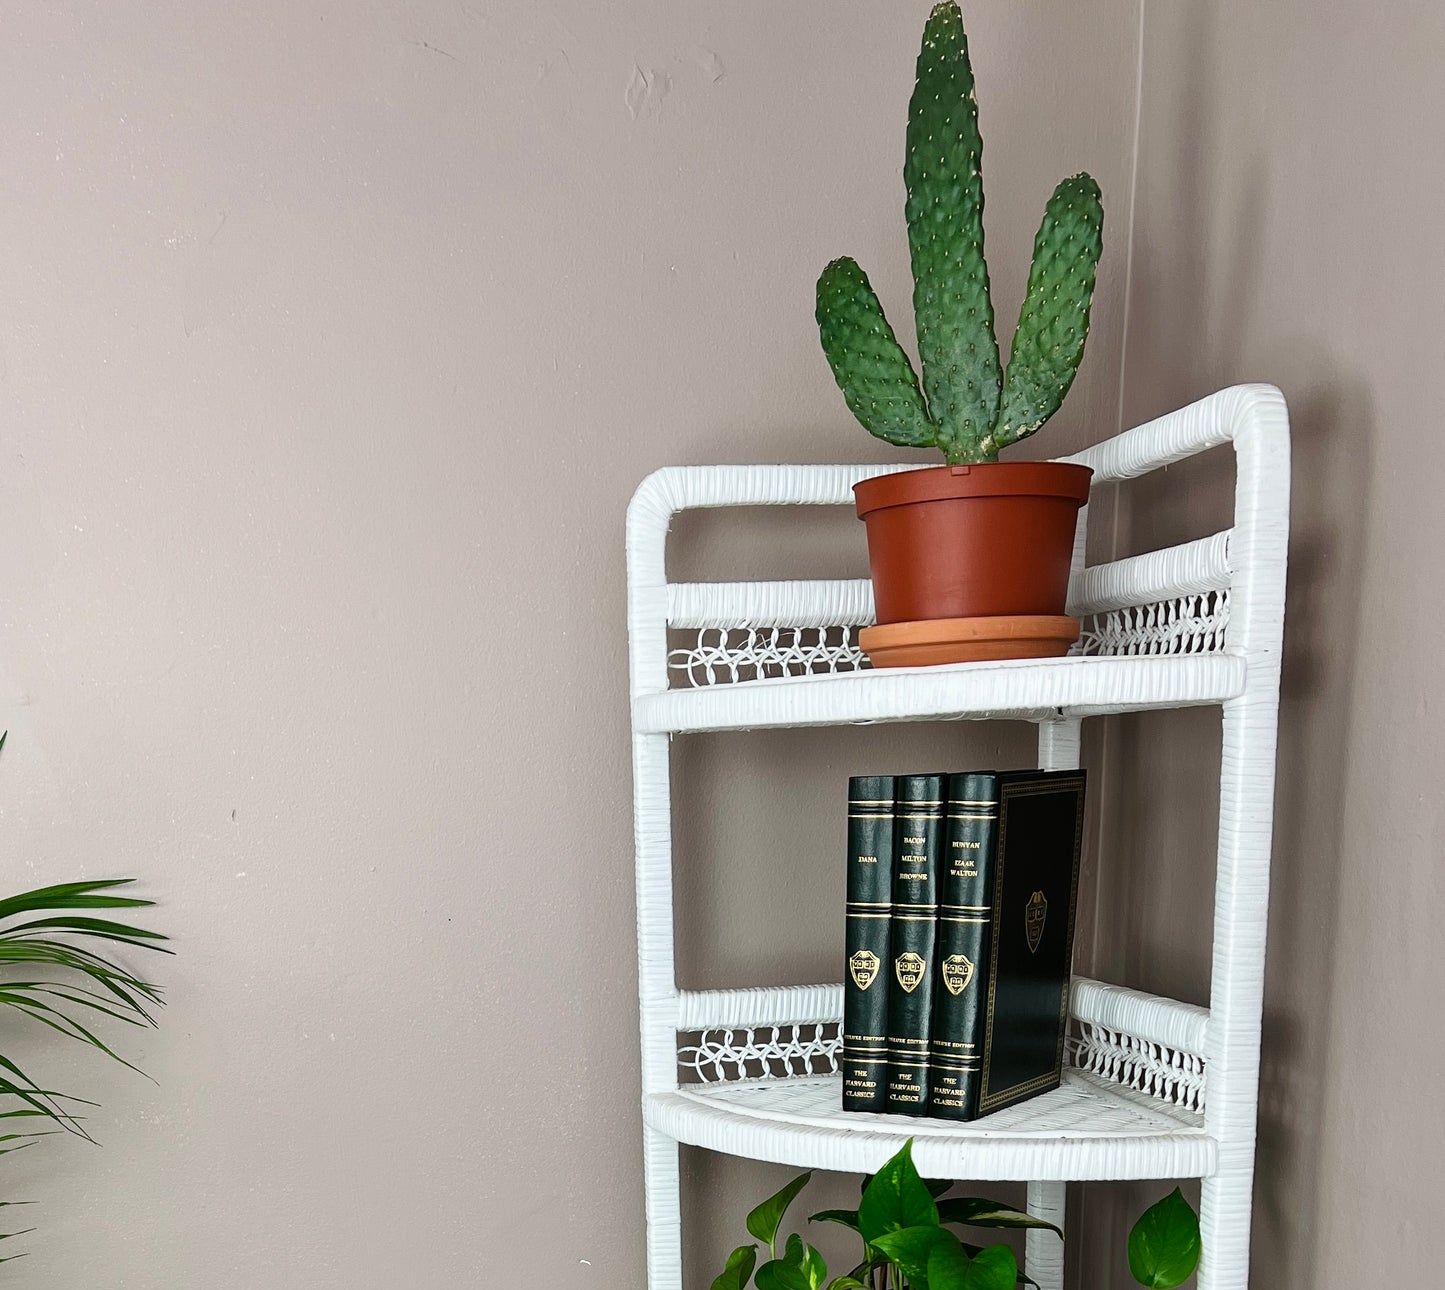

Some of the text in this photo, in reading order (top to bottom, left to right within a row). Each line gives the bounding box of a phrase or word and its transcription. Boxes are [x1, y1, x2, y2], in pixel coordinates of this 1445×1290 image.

[952, 841, 980, 849] BUNYAN
[950, 869, 978, 877] WALTON
[898, 1073, 913, 1081] THE
[943, 1077, 958, 1085] THE
[845, 1080, 877, 1088] HARVARD
[889, 1083, 921, 1092] HARVARD
[933, 1087, 966, 1096] HARVARD
[889, 1094, 920, 1102] CLASSICS
[933, 1098, 964, 1107] CLASSICS
